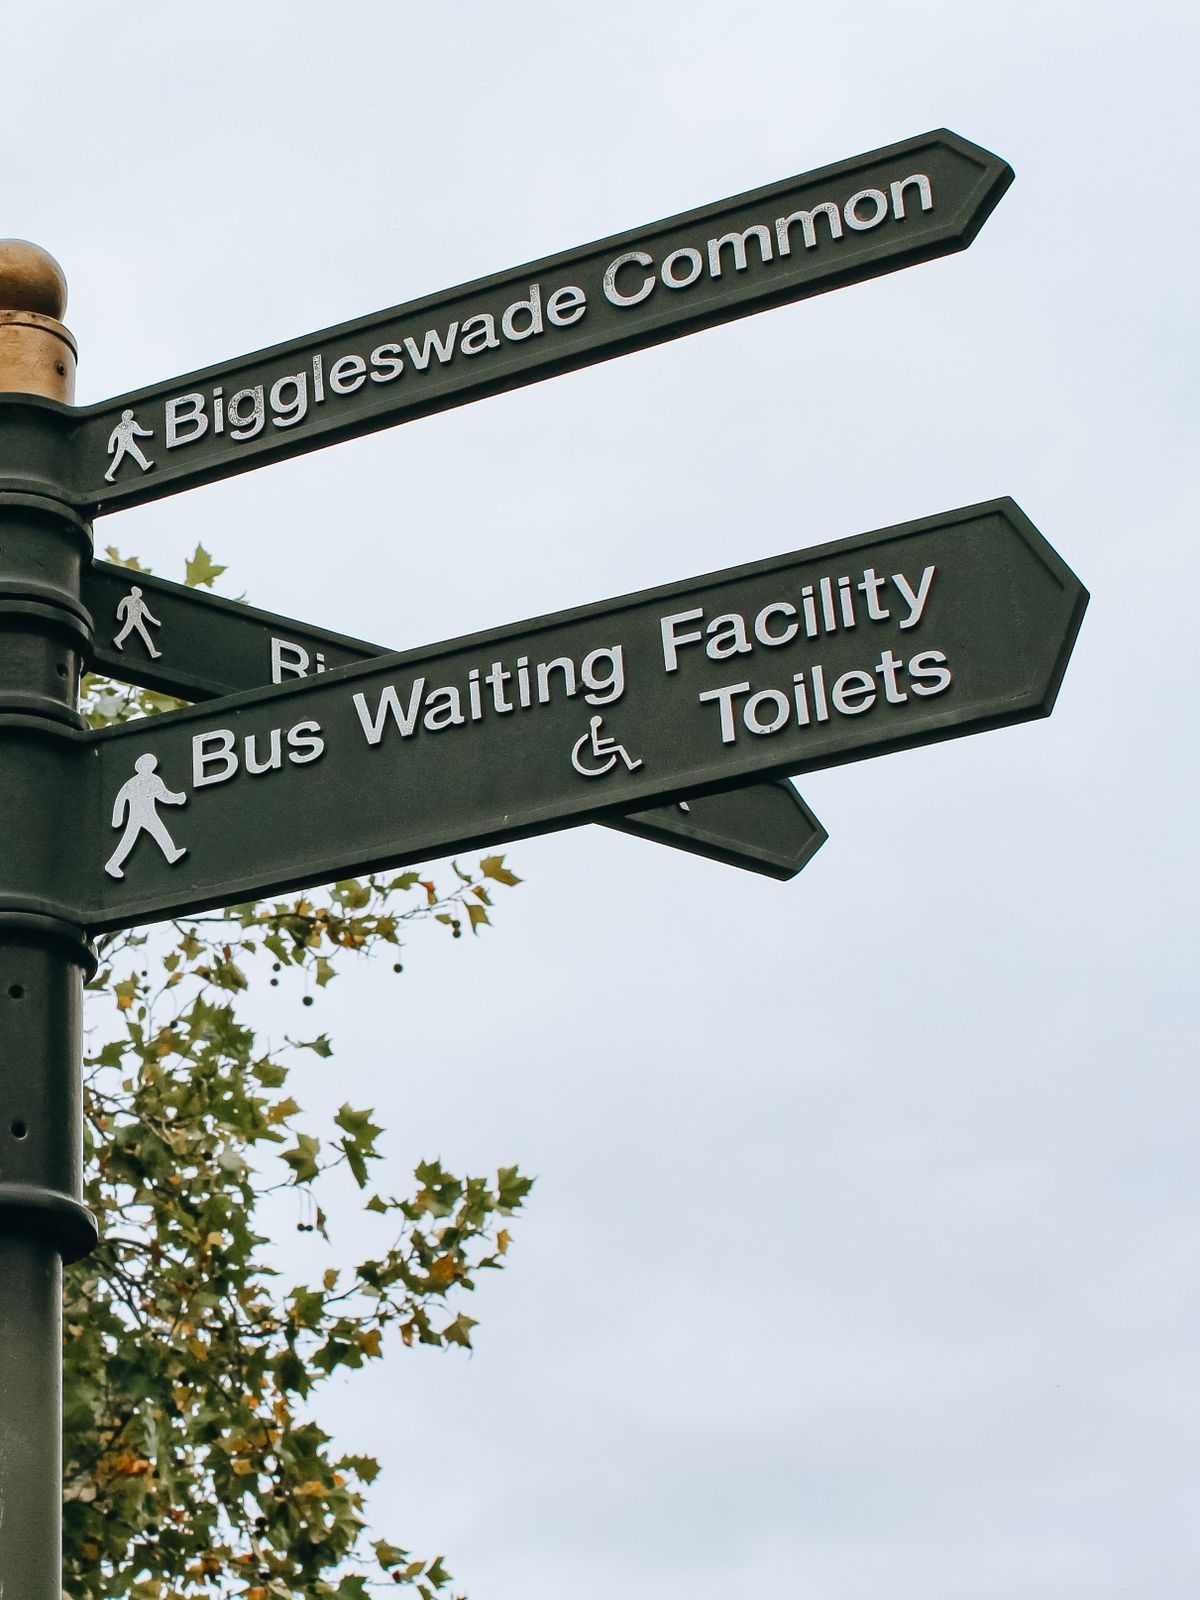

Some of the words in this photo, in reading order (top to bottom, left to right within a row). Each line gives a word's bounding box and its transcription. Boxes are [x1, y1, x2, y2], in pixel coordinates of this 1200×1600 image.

[164, 283, 588, 449] Biggleswade
[602, 172, 934, 308] Common
[191, 720, 326, 789] Bus
[352, 644, 626, 746] Waiting
[659, 565, 937, 673] Facility
[698, 649, 953, 744] Toilets
